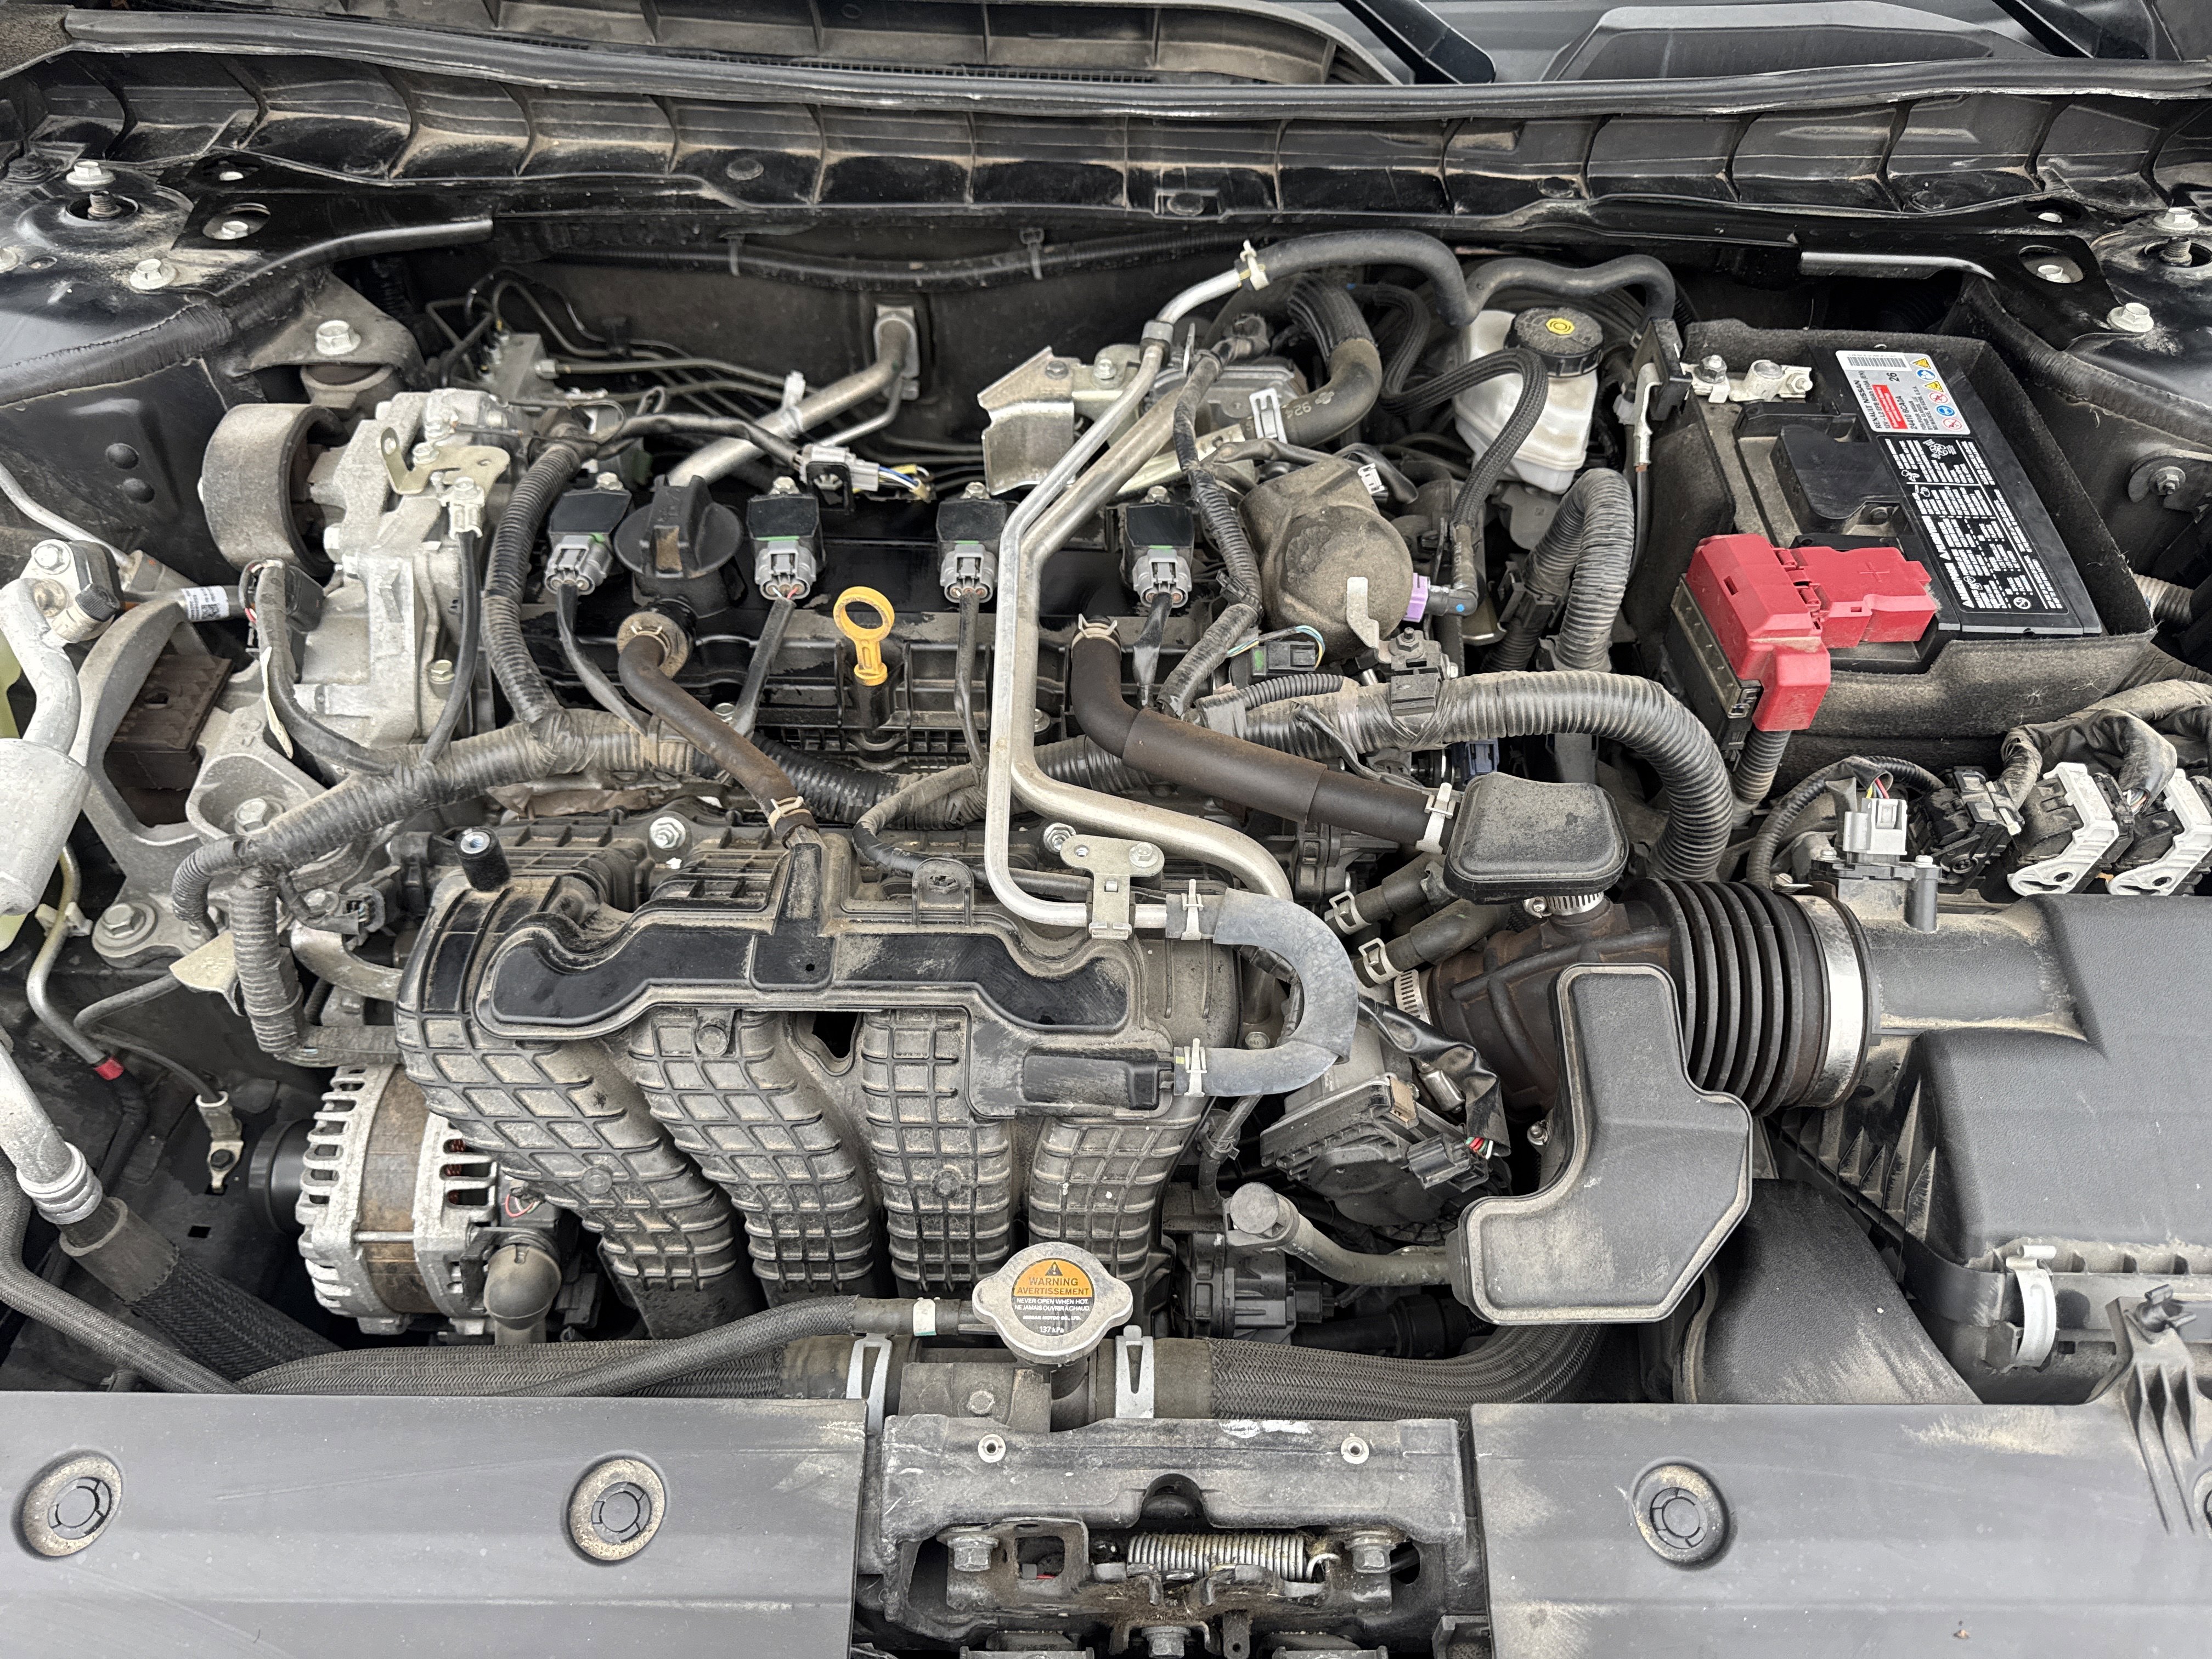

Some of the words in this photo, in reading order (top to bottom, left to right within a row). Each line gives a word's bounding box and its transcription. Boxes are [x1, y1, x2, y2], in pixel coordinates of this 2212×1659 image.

[1886, 372, 1900, 382] 26
[1853, 380, 1870, 403] NISSAN
[1894, 396, 1910, 413] 6CA0A
[1865, 405, 1882, 428] RENAULT
[1904, 414, 1918, 429] 24410
[1029, 1277, 1078, 1286] WARNING
